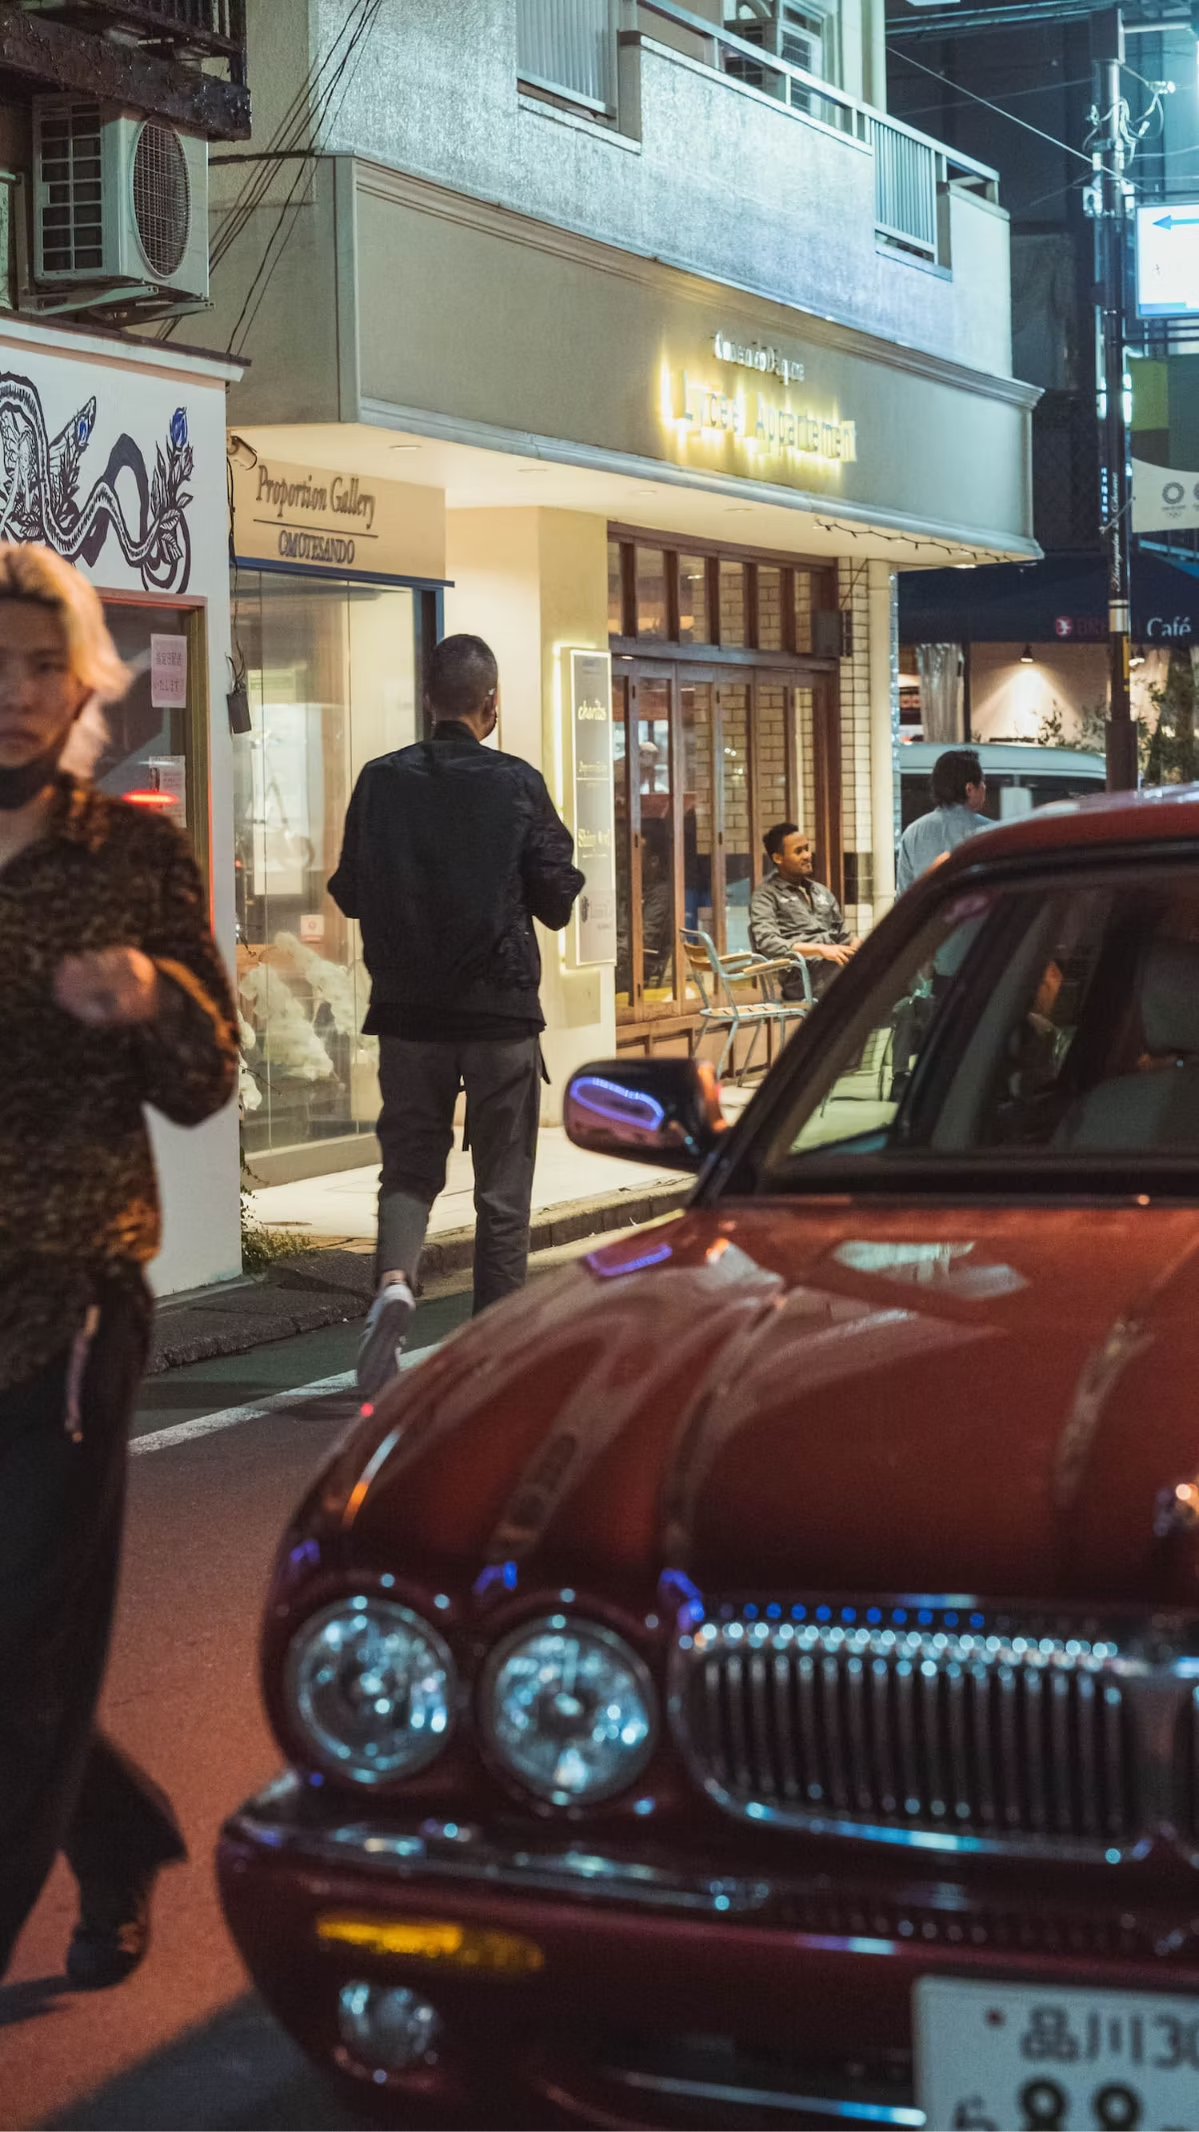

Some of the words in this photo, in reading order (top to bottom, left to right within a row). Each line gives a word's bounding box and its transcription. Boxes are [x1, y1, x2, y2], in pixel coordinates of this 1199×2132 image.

[256, 464, 328, 518] Proportion
[330, 476, 376, 530] Gallery
[278, 529, 355, 564] OMOTESANDO
[1147, 616, 1192, 637] Café
